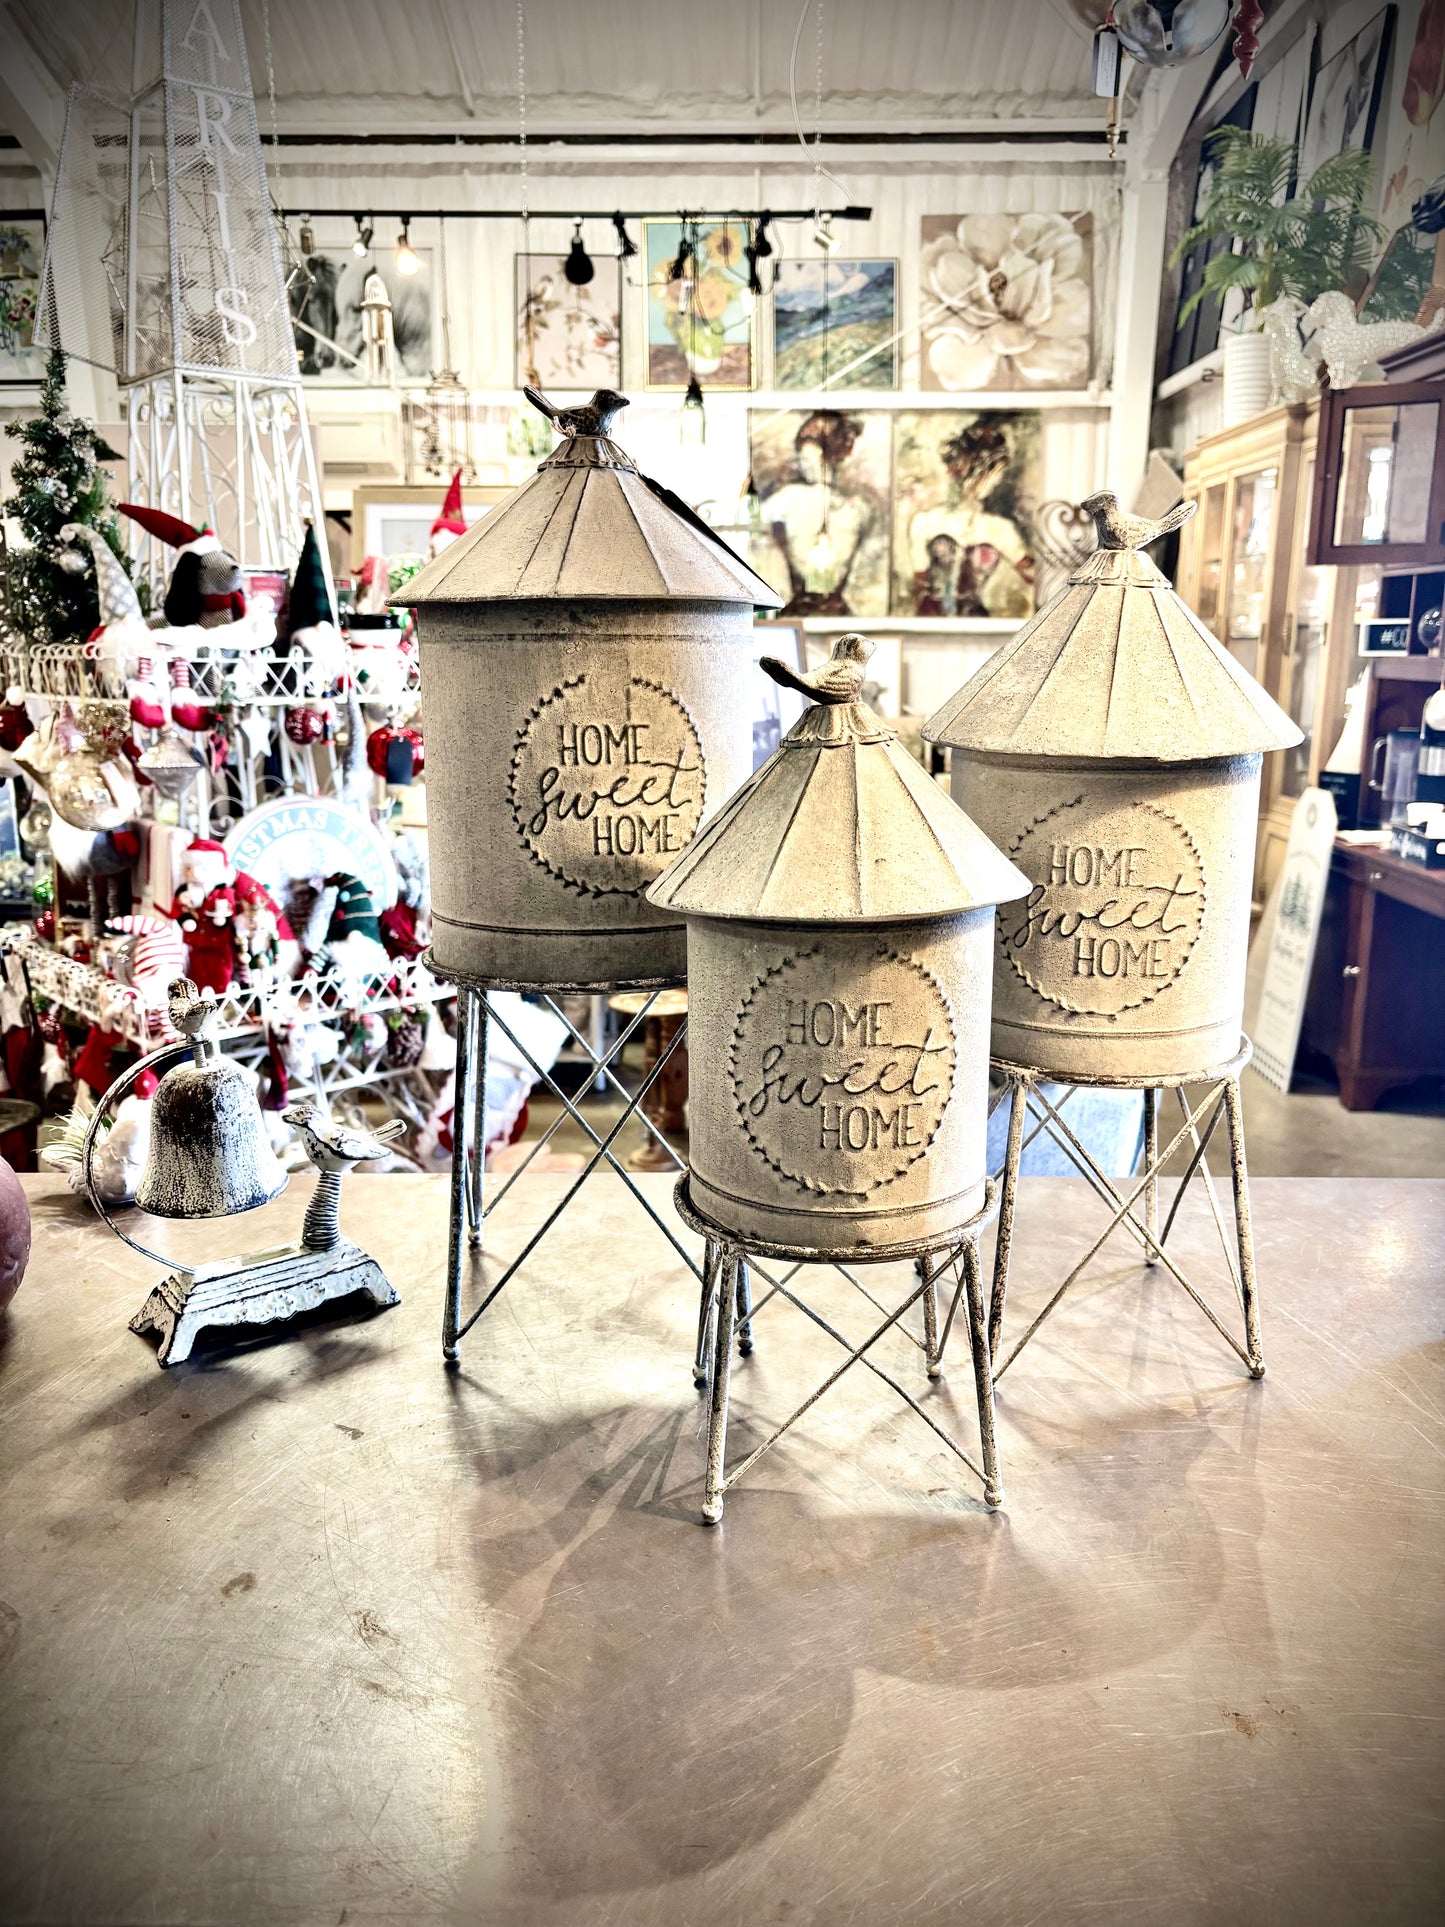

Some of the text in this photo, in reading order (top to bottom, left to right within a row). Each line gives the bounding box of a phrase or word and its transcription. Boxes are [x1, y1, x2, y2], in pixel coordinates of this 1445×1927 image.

[558, 723, 650, 765] HOME
[232, 808, 329, 873] ISTMAS
[592, 813, 682, 856] HOME
[1050, 846, 1148, 888] HOME
[1073, 938, 1171, 978] HOME
[786, 1000, 894, 1048] HOME
[820, 1103, 923, 1151] HOME
